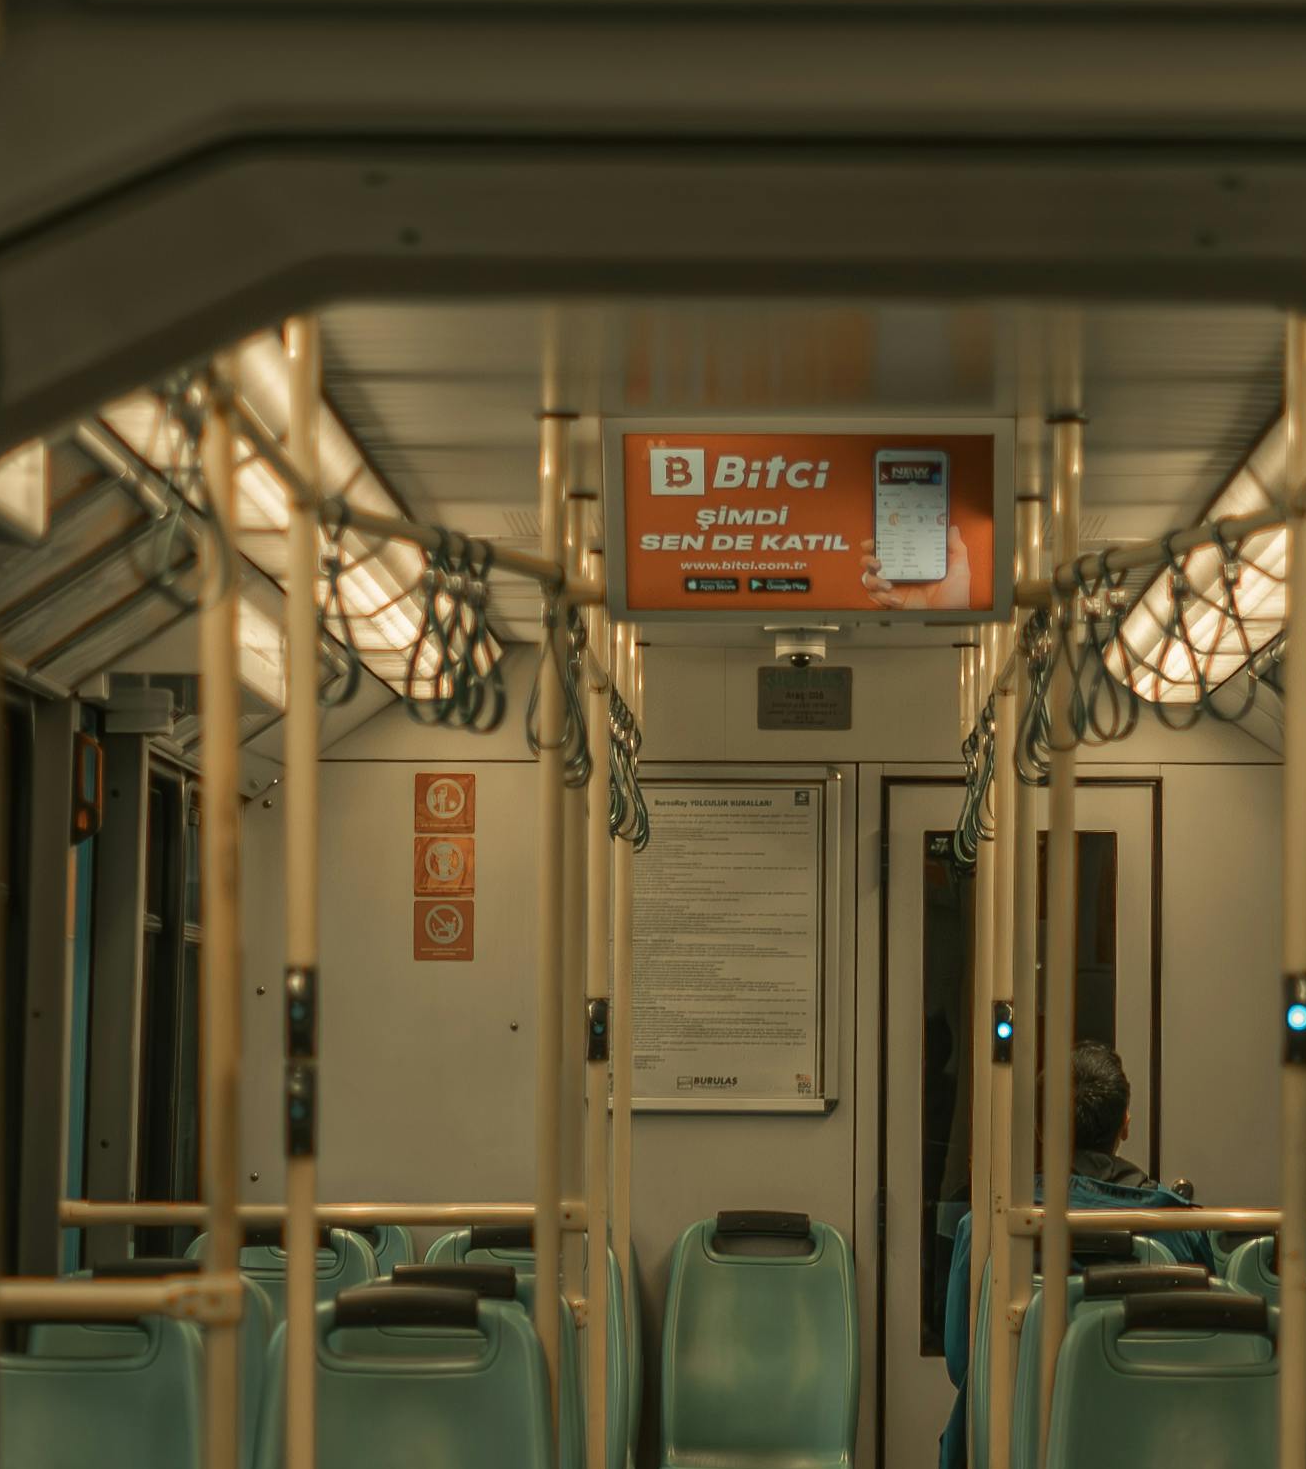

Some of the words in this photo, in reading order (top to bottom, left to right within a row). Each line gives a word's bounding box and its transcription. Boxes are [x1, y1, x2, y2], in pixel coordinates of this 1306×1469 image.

[712, 455, 830, 489] Bitci
[892, 466, 929, 475] NEW
[695, 505, 789, 531] ŞİMDİ
[639, 534, 704, 551] SEN
[711, 534, 754, 551] DE
[760, 534, 850, 551] KATIL
[680, 561, 807, 571] www.bitci.com.tr
[699, 583, 715, 591] App
[766, 583, 791, 591] Google
[792, 583, 807, 591] Play
[693, 1077, 738, 1087] BURULAŞ
